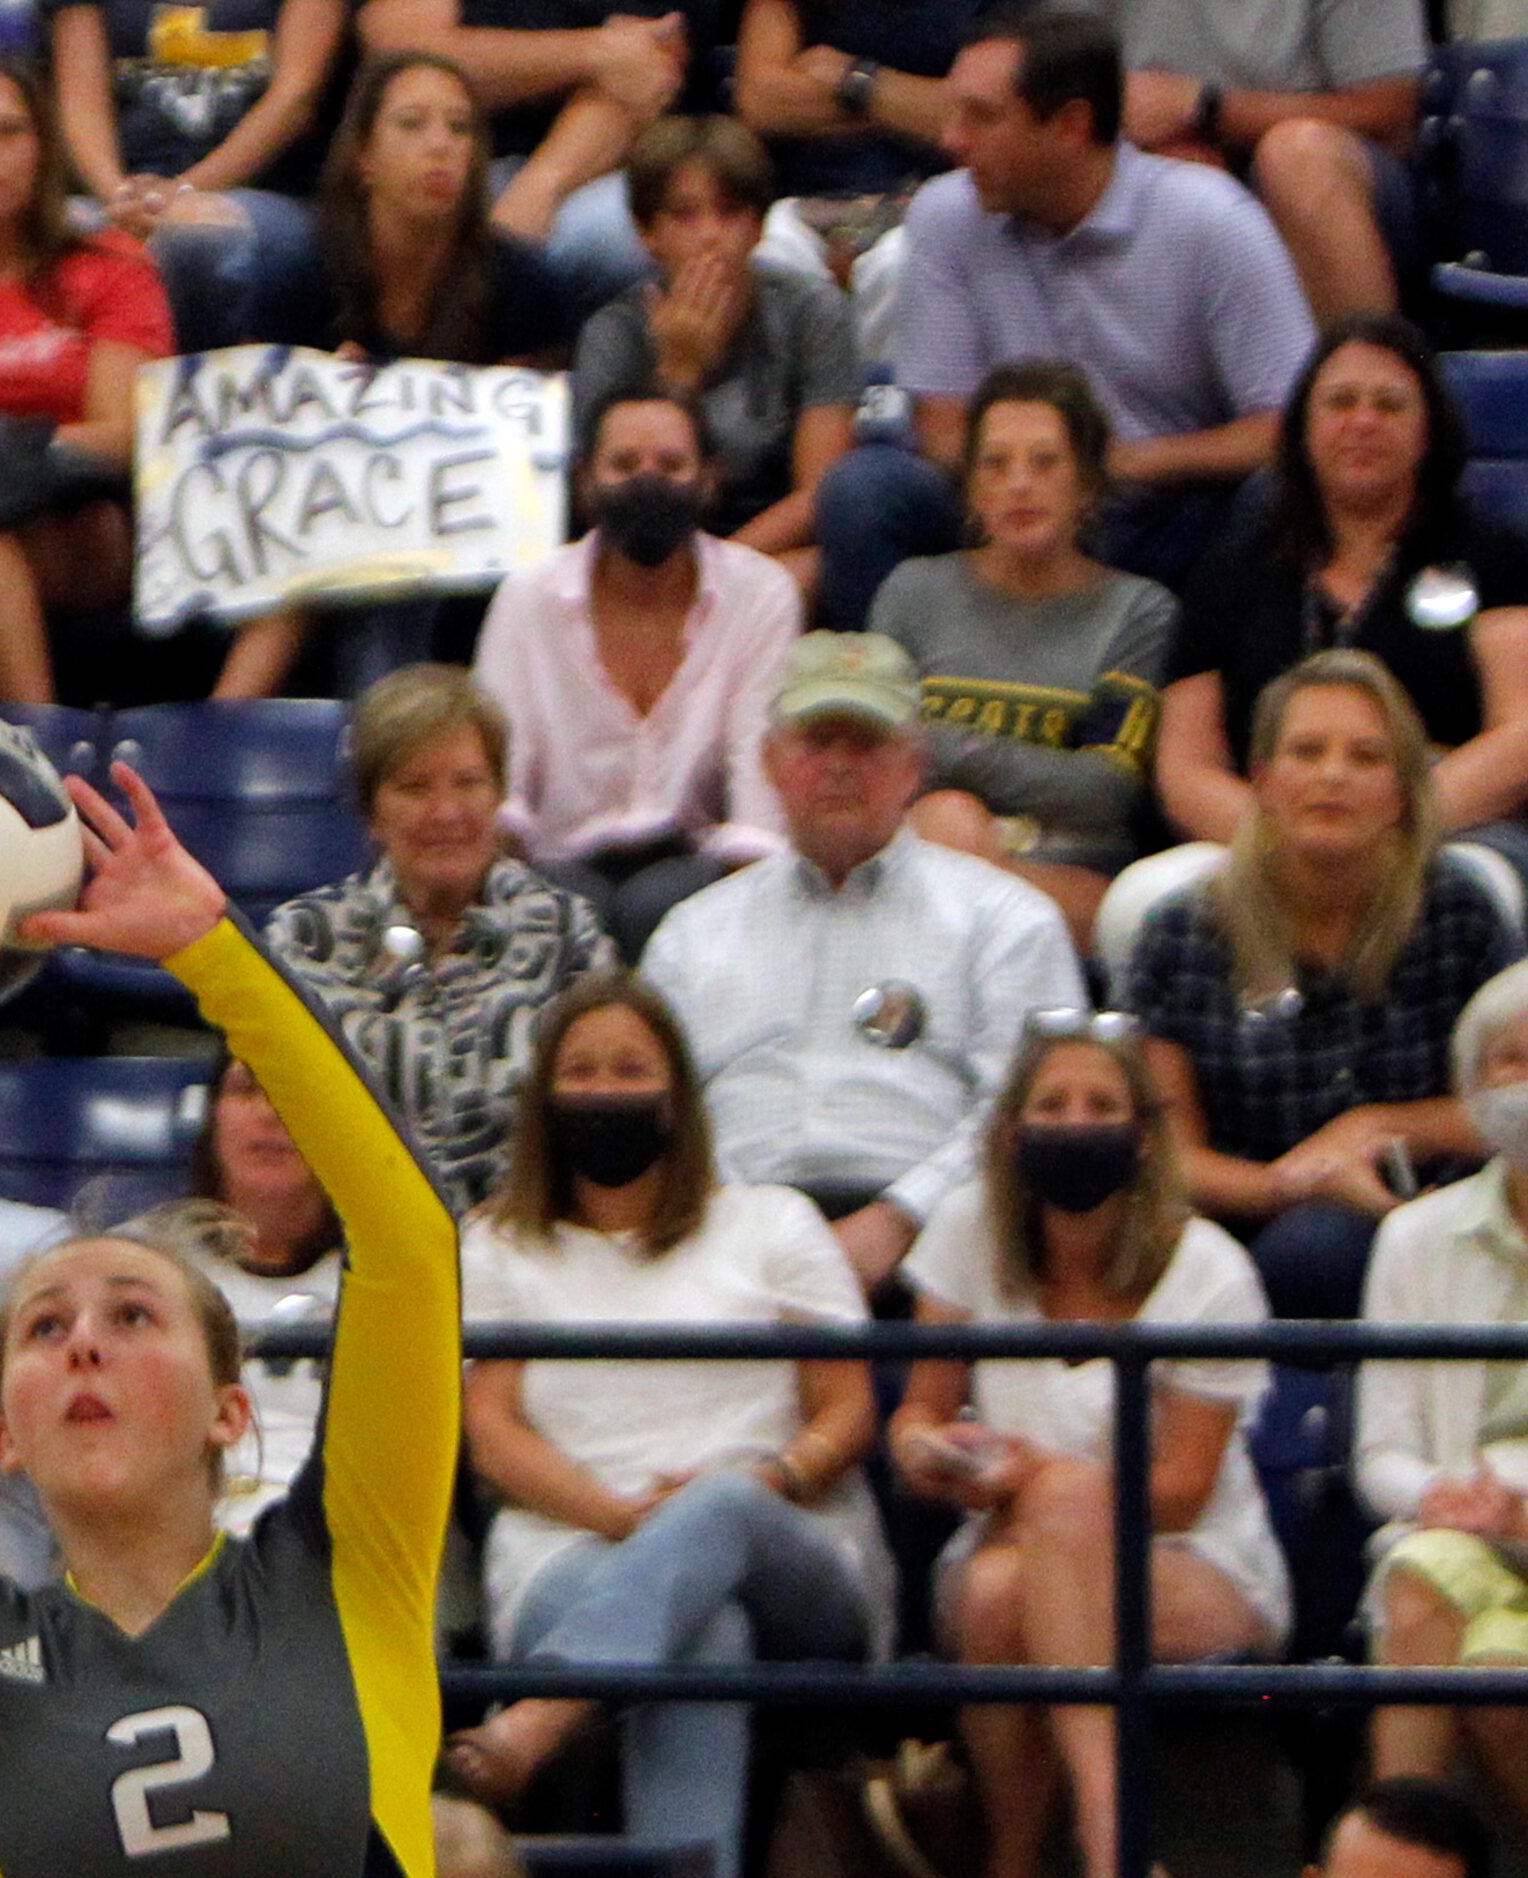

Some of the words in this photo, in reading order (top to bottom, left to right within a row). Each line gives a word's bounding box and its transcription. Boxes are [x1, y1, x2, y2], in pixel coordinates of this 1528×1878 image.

[160, 362, 544, 446] AMAZING
[176, 448, 499, 586] GRACE
[105, 1704, 231, 1858] 2
